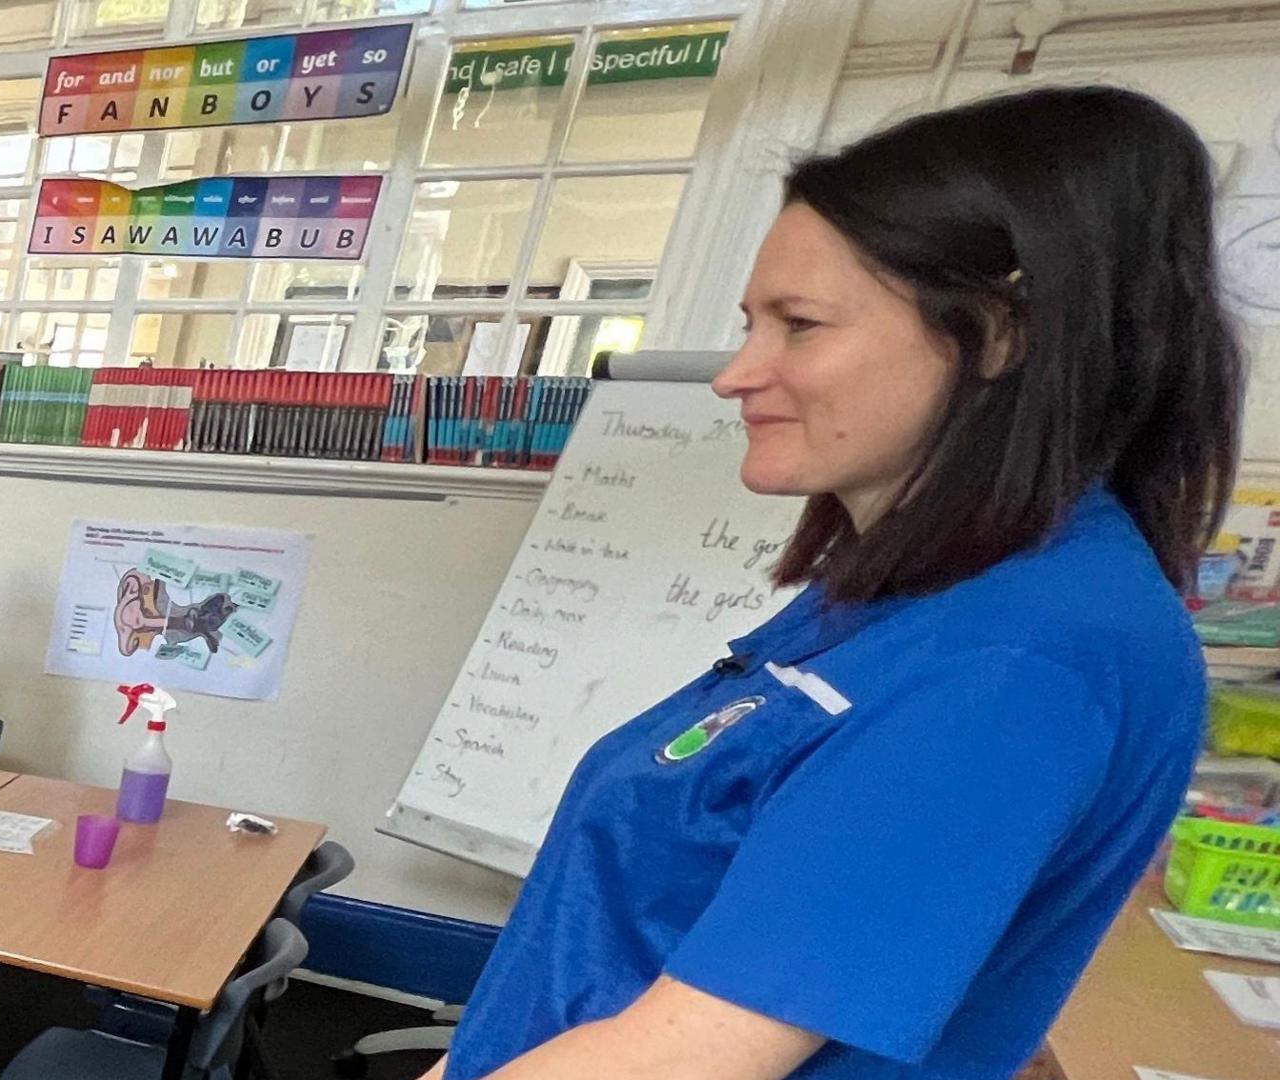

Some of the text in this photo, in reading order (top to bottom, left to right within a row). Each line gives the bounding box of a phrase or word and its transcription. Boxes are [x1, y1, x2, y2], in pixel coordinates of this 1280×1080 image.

[54, 48, 386, 92] for and nor but or yet so
[496, 55, 541, 77] safe
[602, 411, 691, 457] Thursday
[582, 466, 636, 488] Maths
[700, 518, 740, 550] the
[666, 574, 700, 607] the
[496, 631, 558, 669] Reading
